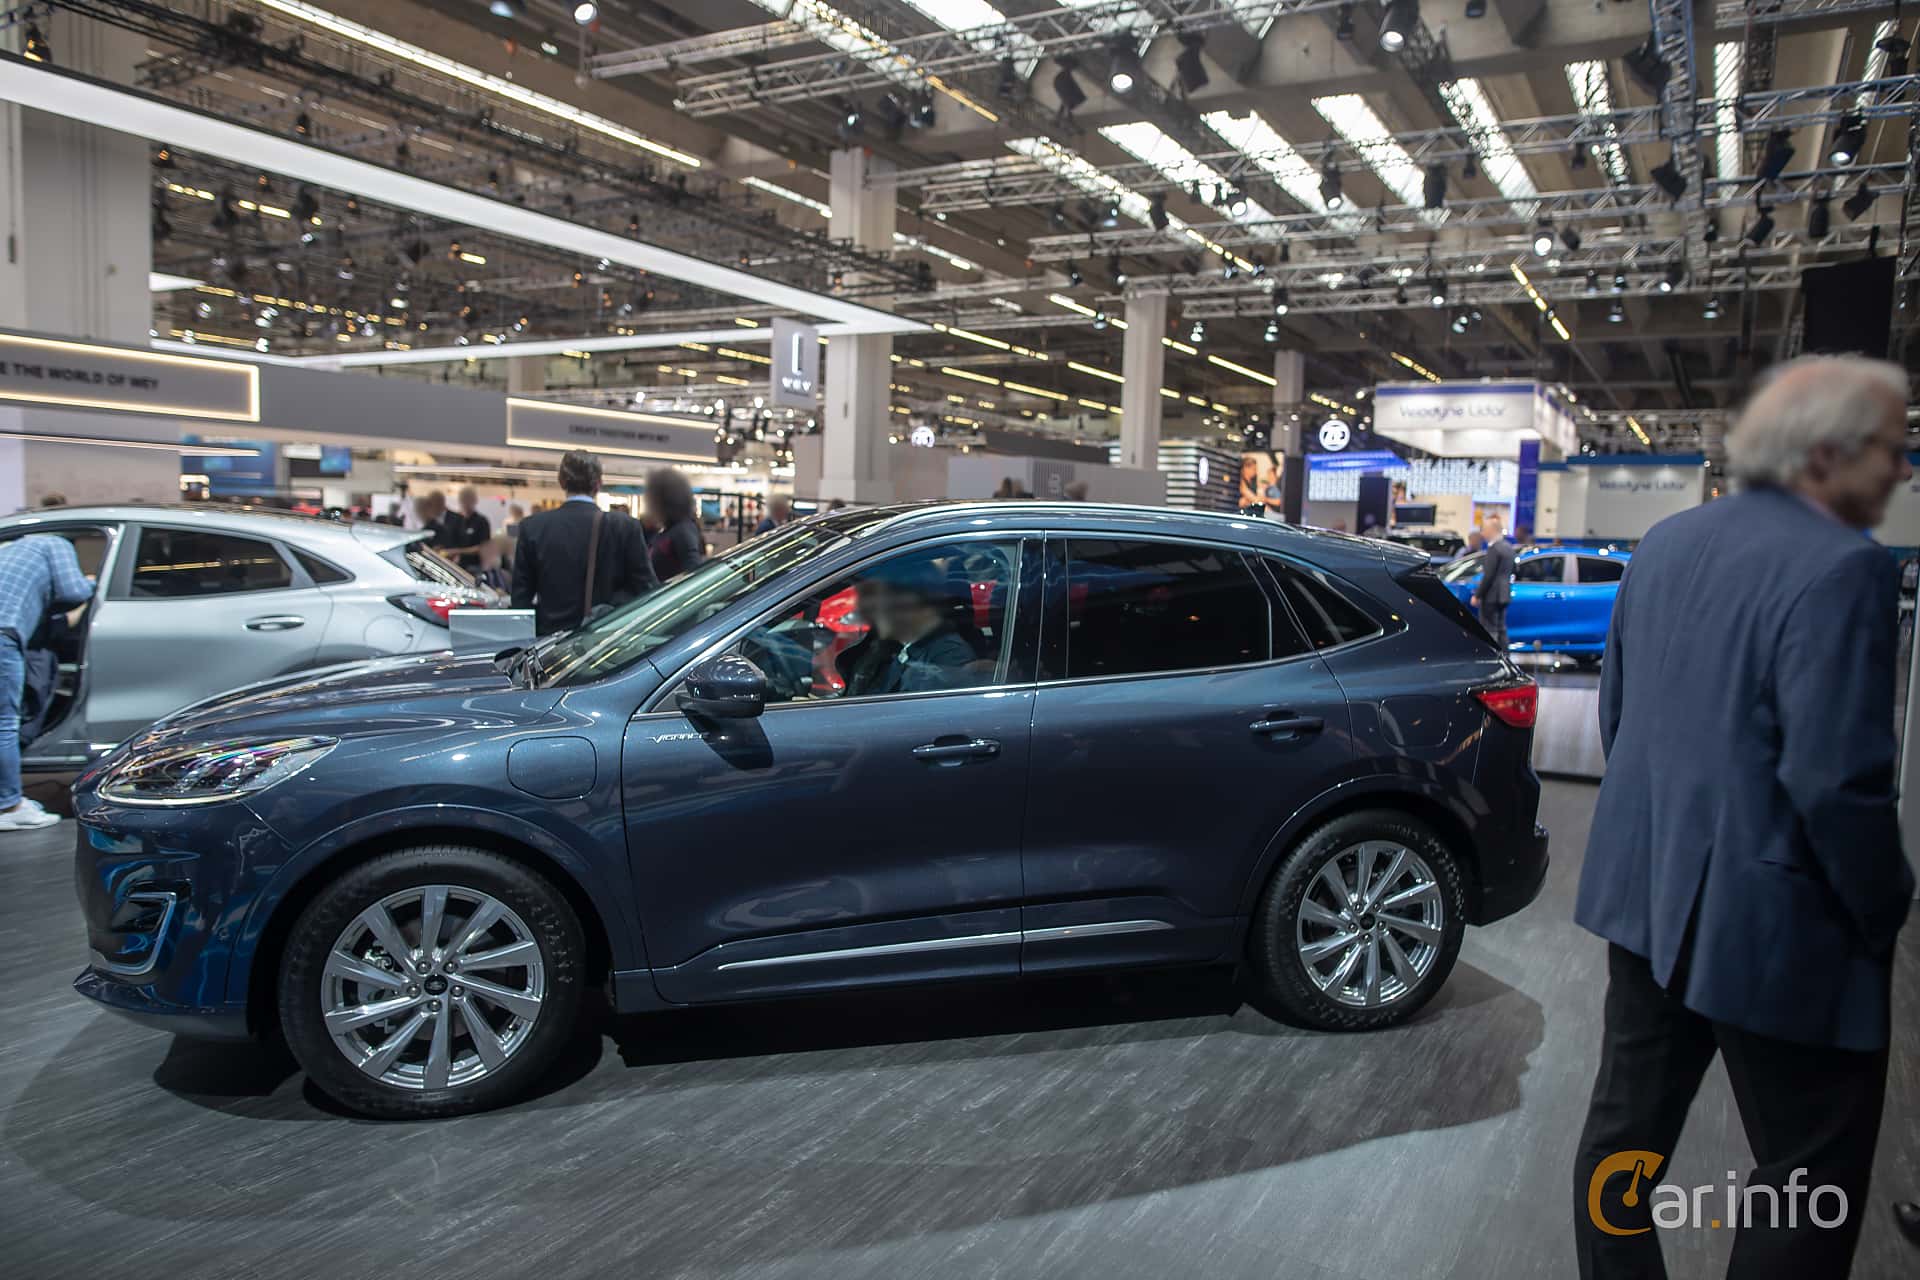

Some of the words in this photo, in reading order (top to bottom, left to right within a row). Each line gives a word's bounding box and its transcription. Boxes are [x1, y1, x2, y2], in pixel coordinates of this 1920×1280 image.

[12, 363, 42, 379] THE
[48, 367, 102, 385] WORLD
[106, 374, 125, 386] OF
